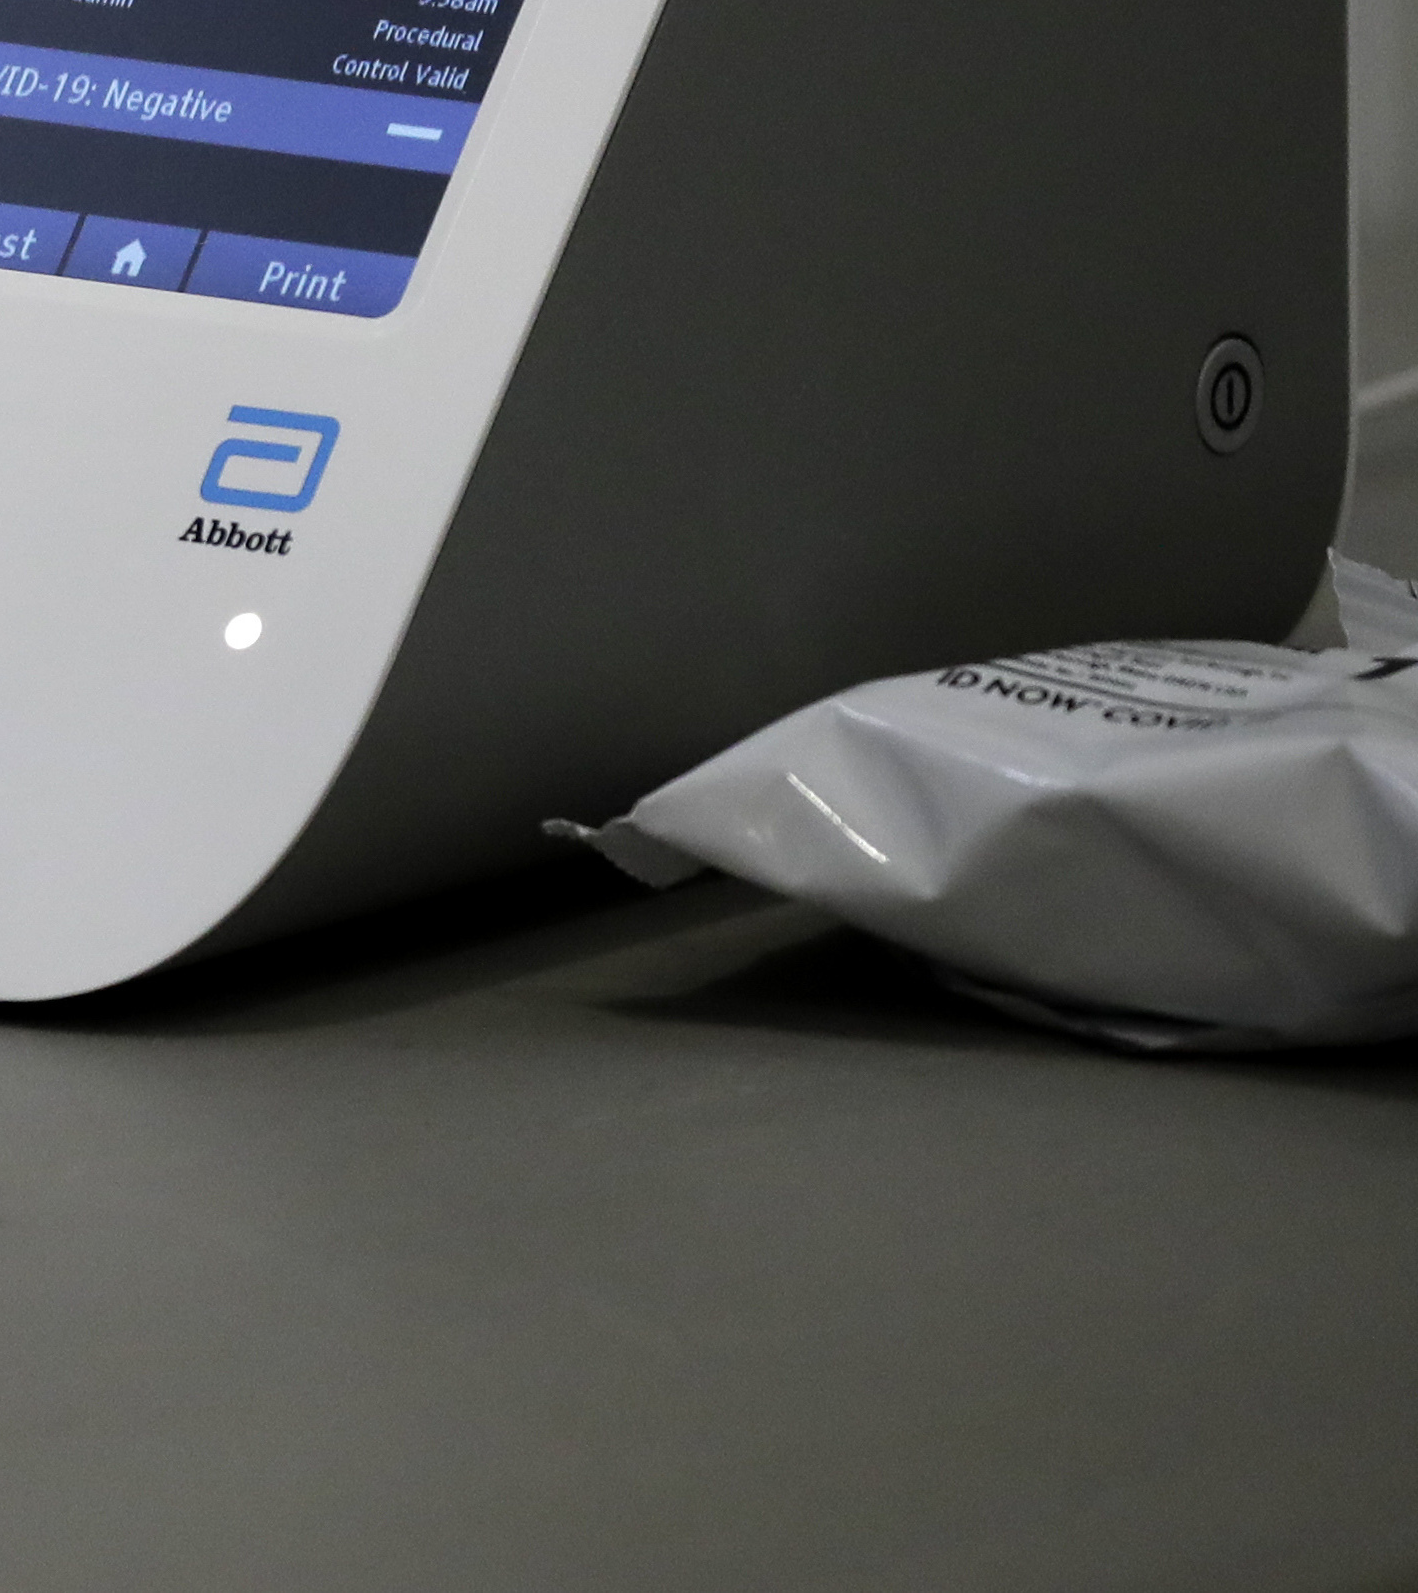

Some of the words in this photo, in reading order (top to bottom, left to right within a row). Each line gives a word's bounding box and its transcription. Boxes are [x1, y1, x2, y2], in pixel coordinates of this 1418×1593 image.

[373, 19, 485, 52] Procedural
[333, 54, 410, 83] Control
[415, 64, 470, 91] Valid
[102, 78, 233, 122] Negative
[259, 259, 347, 303] Print
[178, 516, 294, 556] Abbott
[937, 668, 981, 688] ID
[983, 677, 1080, 713] NOW
